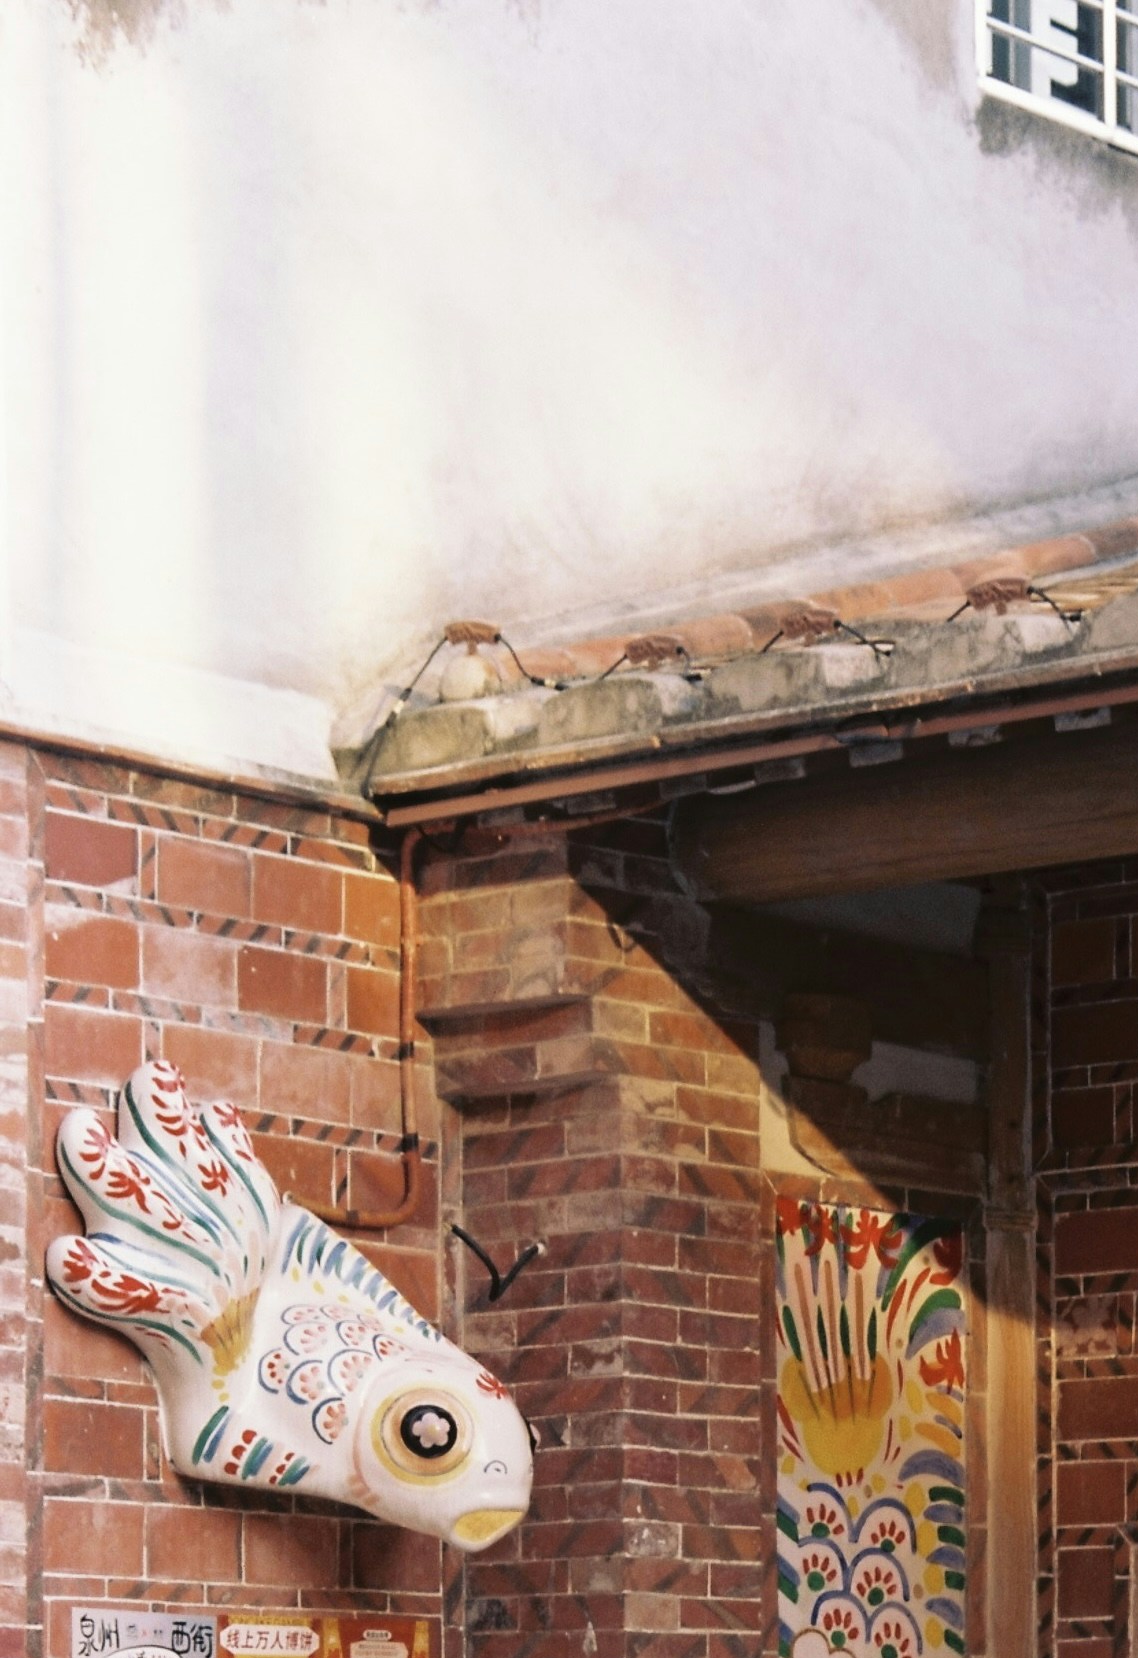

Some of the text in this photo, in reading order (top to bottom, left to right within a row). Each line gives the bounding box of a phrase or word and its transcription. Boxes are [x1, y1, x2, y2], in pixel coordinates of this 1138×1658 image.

[78, 1613, 120, 1657] 泉州
[226, 1629, 314, 1651] 线上万人博饼
